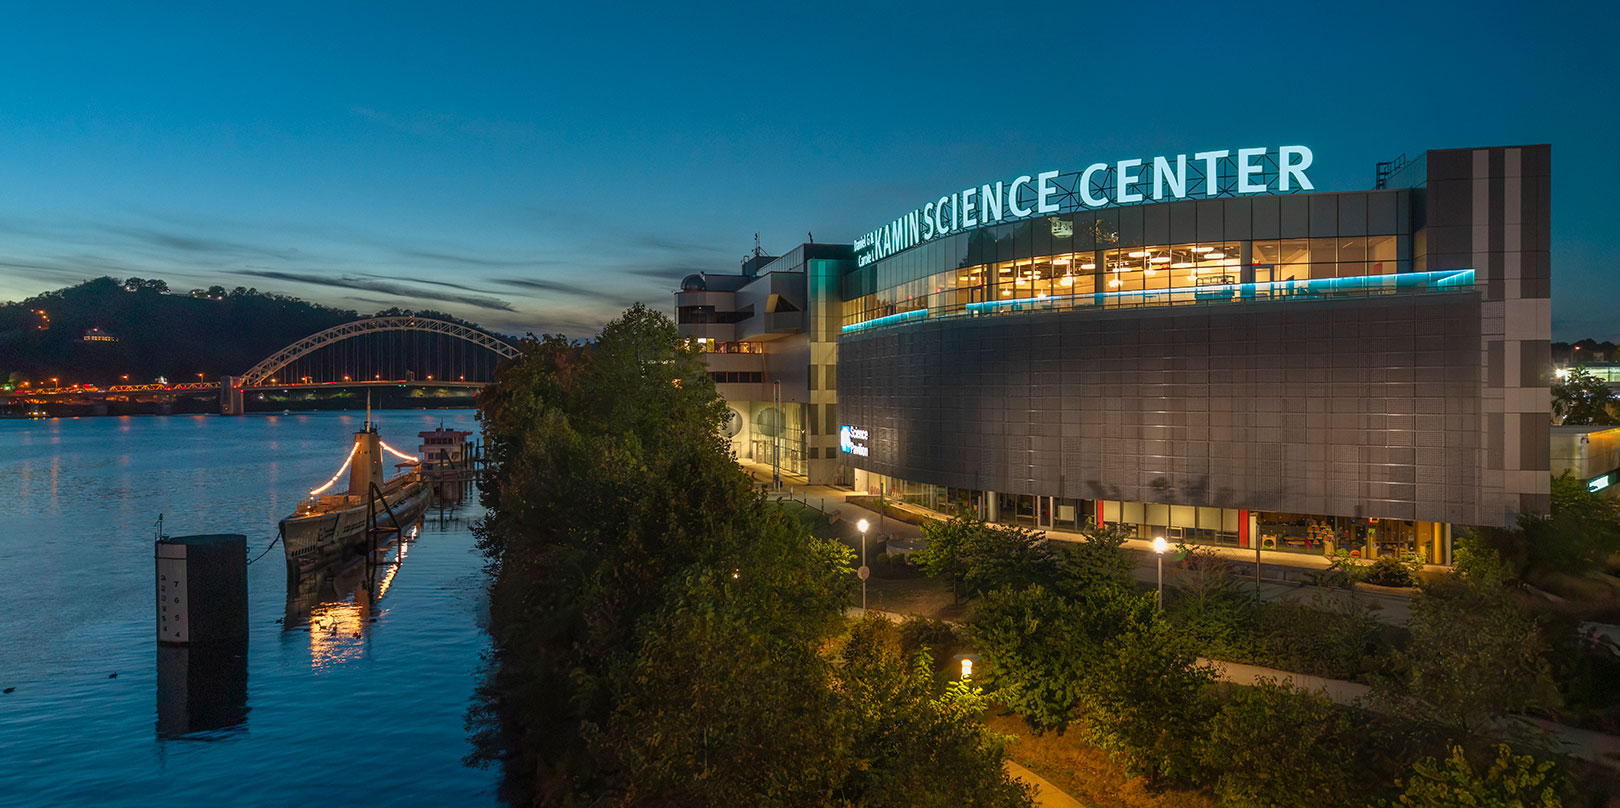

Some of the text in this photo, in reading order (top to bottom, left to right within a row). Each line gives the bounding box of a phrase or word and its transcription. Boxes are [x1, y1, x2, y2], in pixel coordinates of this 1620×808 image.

[924, 145, 1315, 240] SCIENCE CENTER
[875, 209, 919, 260] KAMIN
[850, 425, 869, 440] Science
[850, 442, 869, 457] Pavilion
